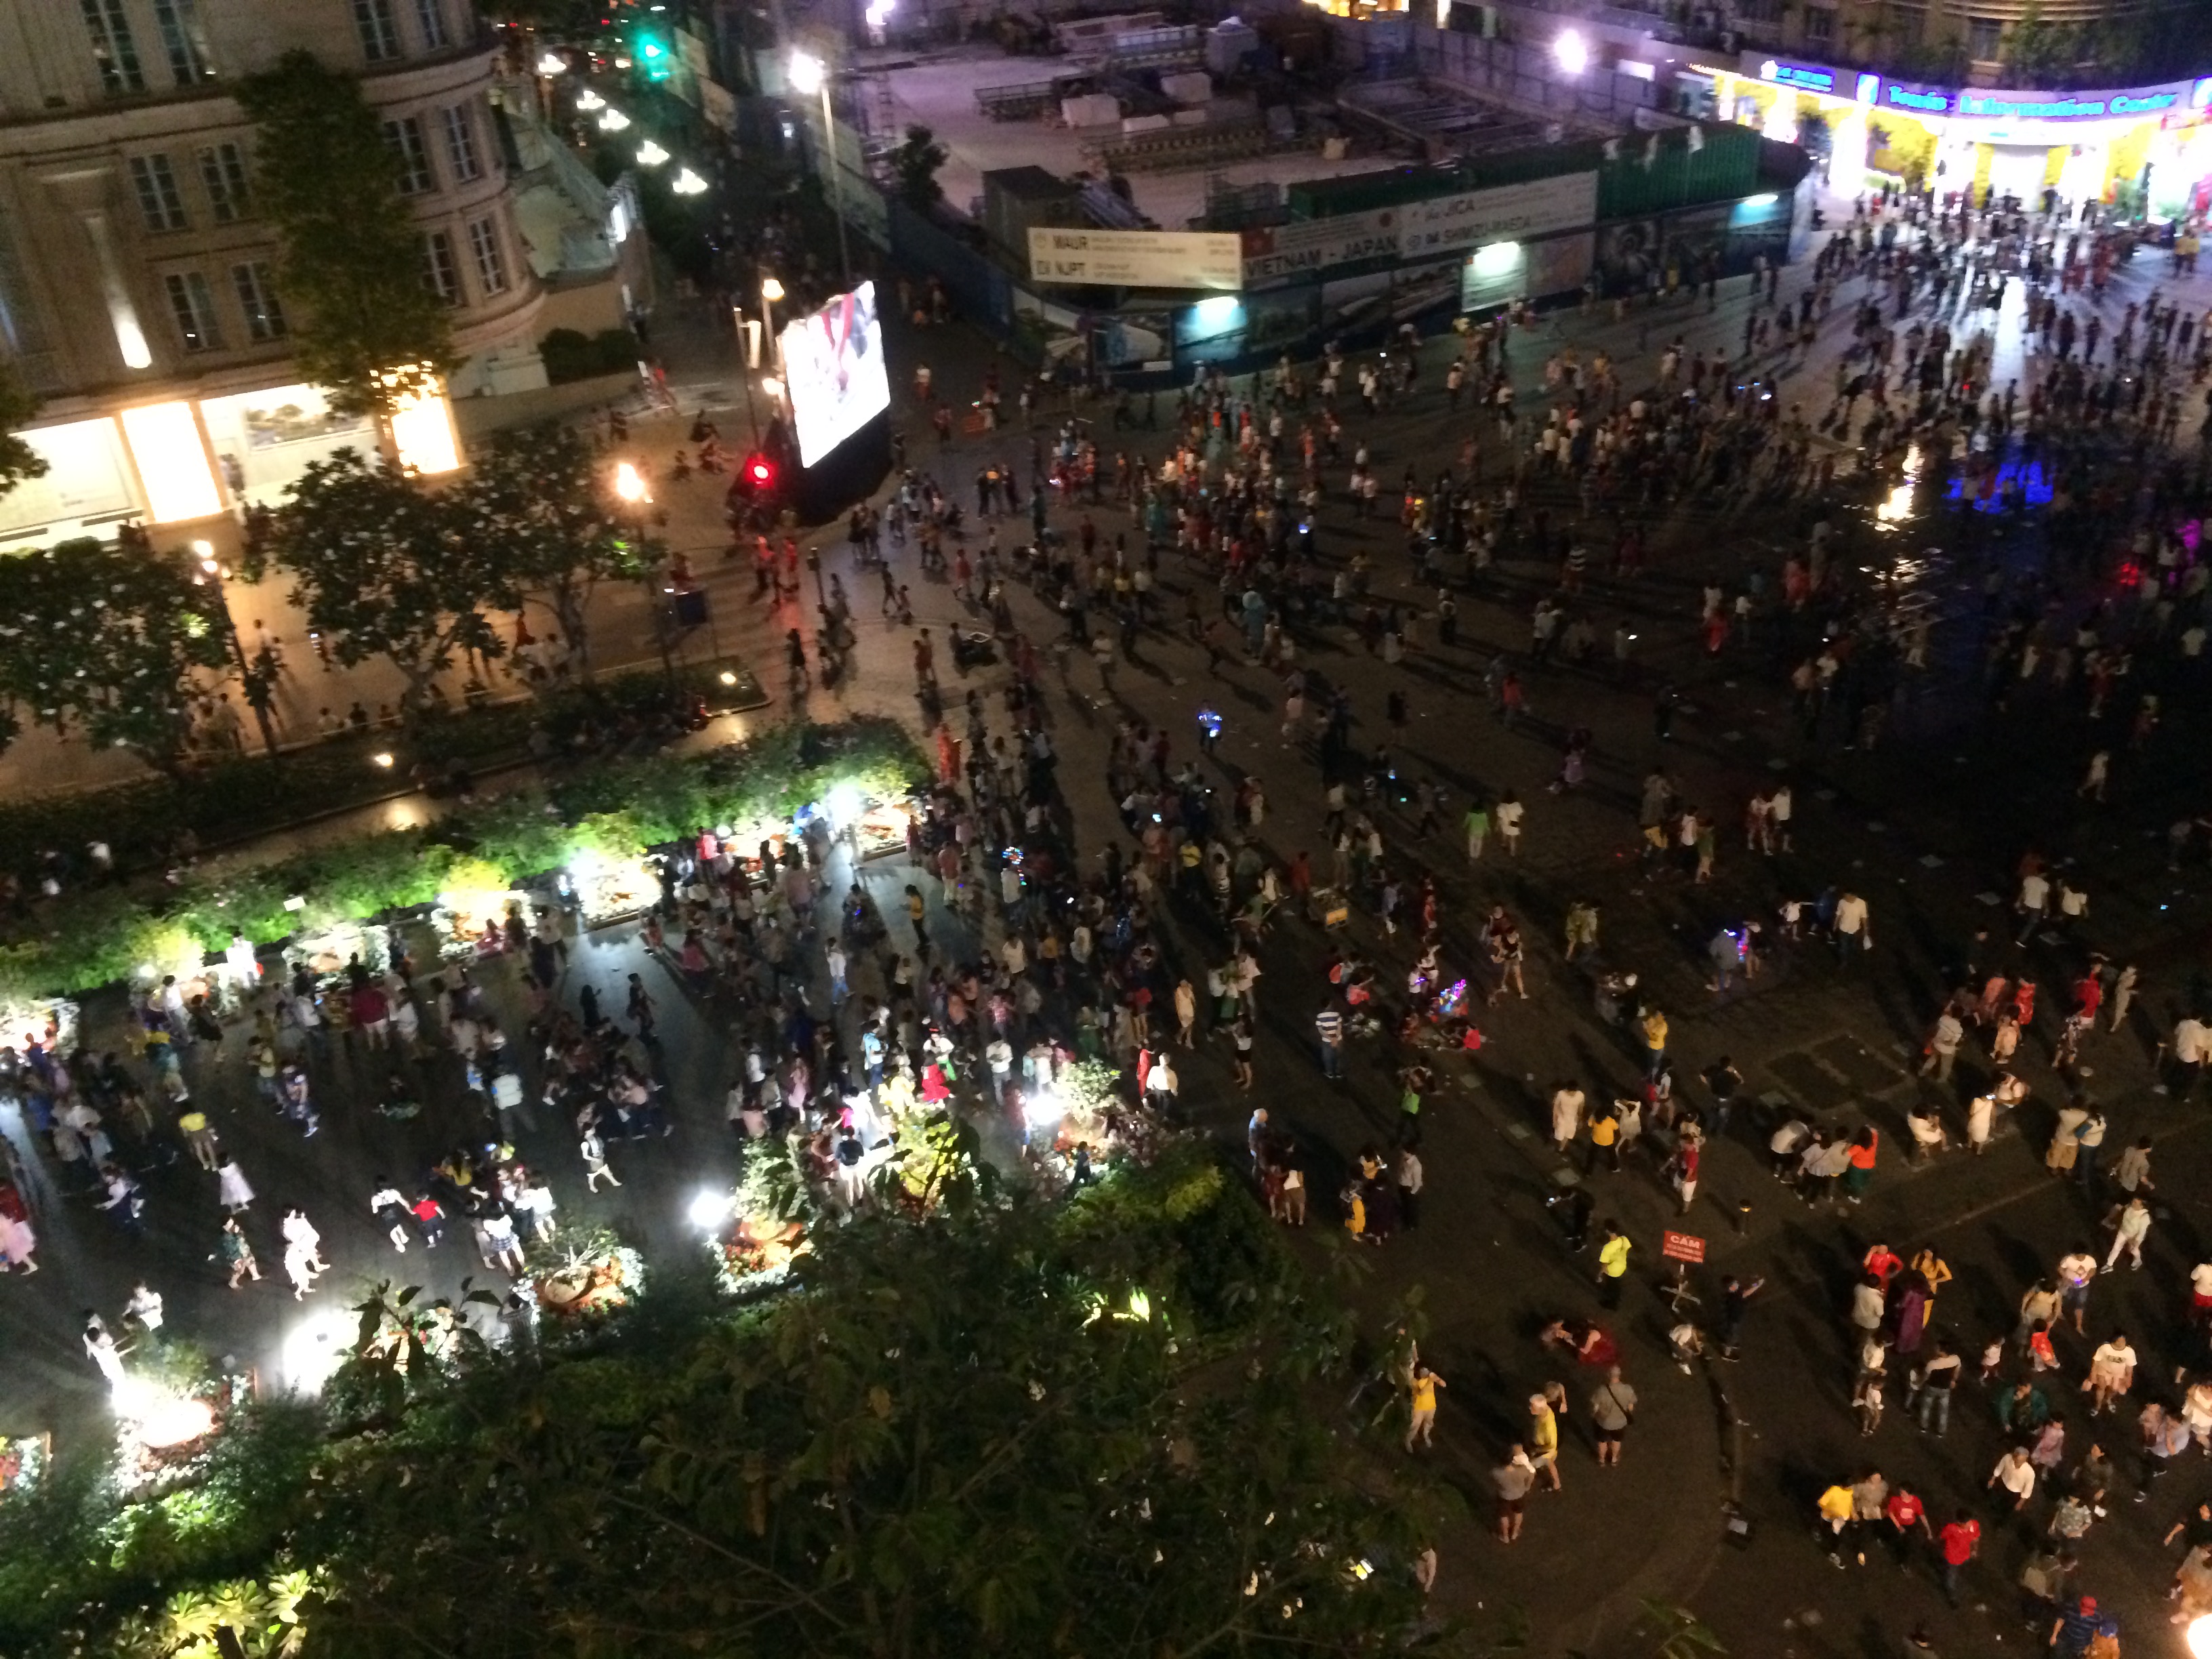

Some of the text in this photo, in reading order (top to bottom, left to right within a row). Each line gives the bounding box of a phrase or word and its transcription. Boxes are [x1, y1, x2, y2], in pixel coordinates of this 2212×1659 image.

[1960, 95, 2105, 117] Information
[1053, 234, 1088, 251] MAUR
[1246, 249, 1321, 276] VIETNAM
[1343, 236, 1397, 260] JAPAN
